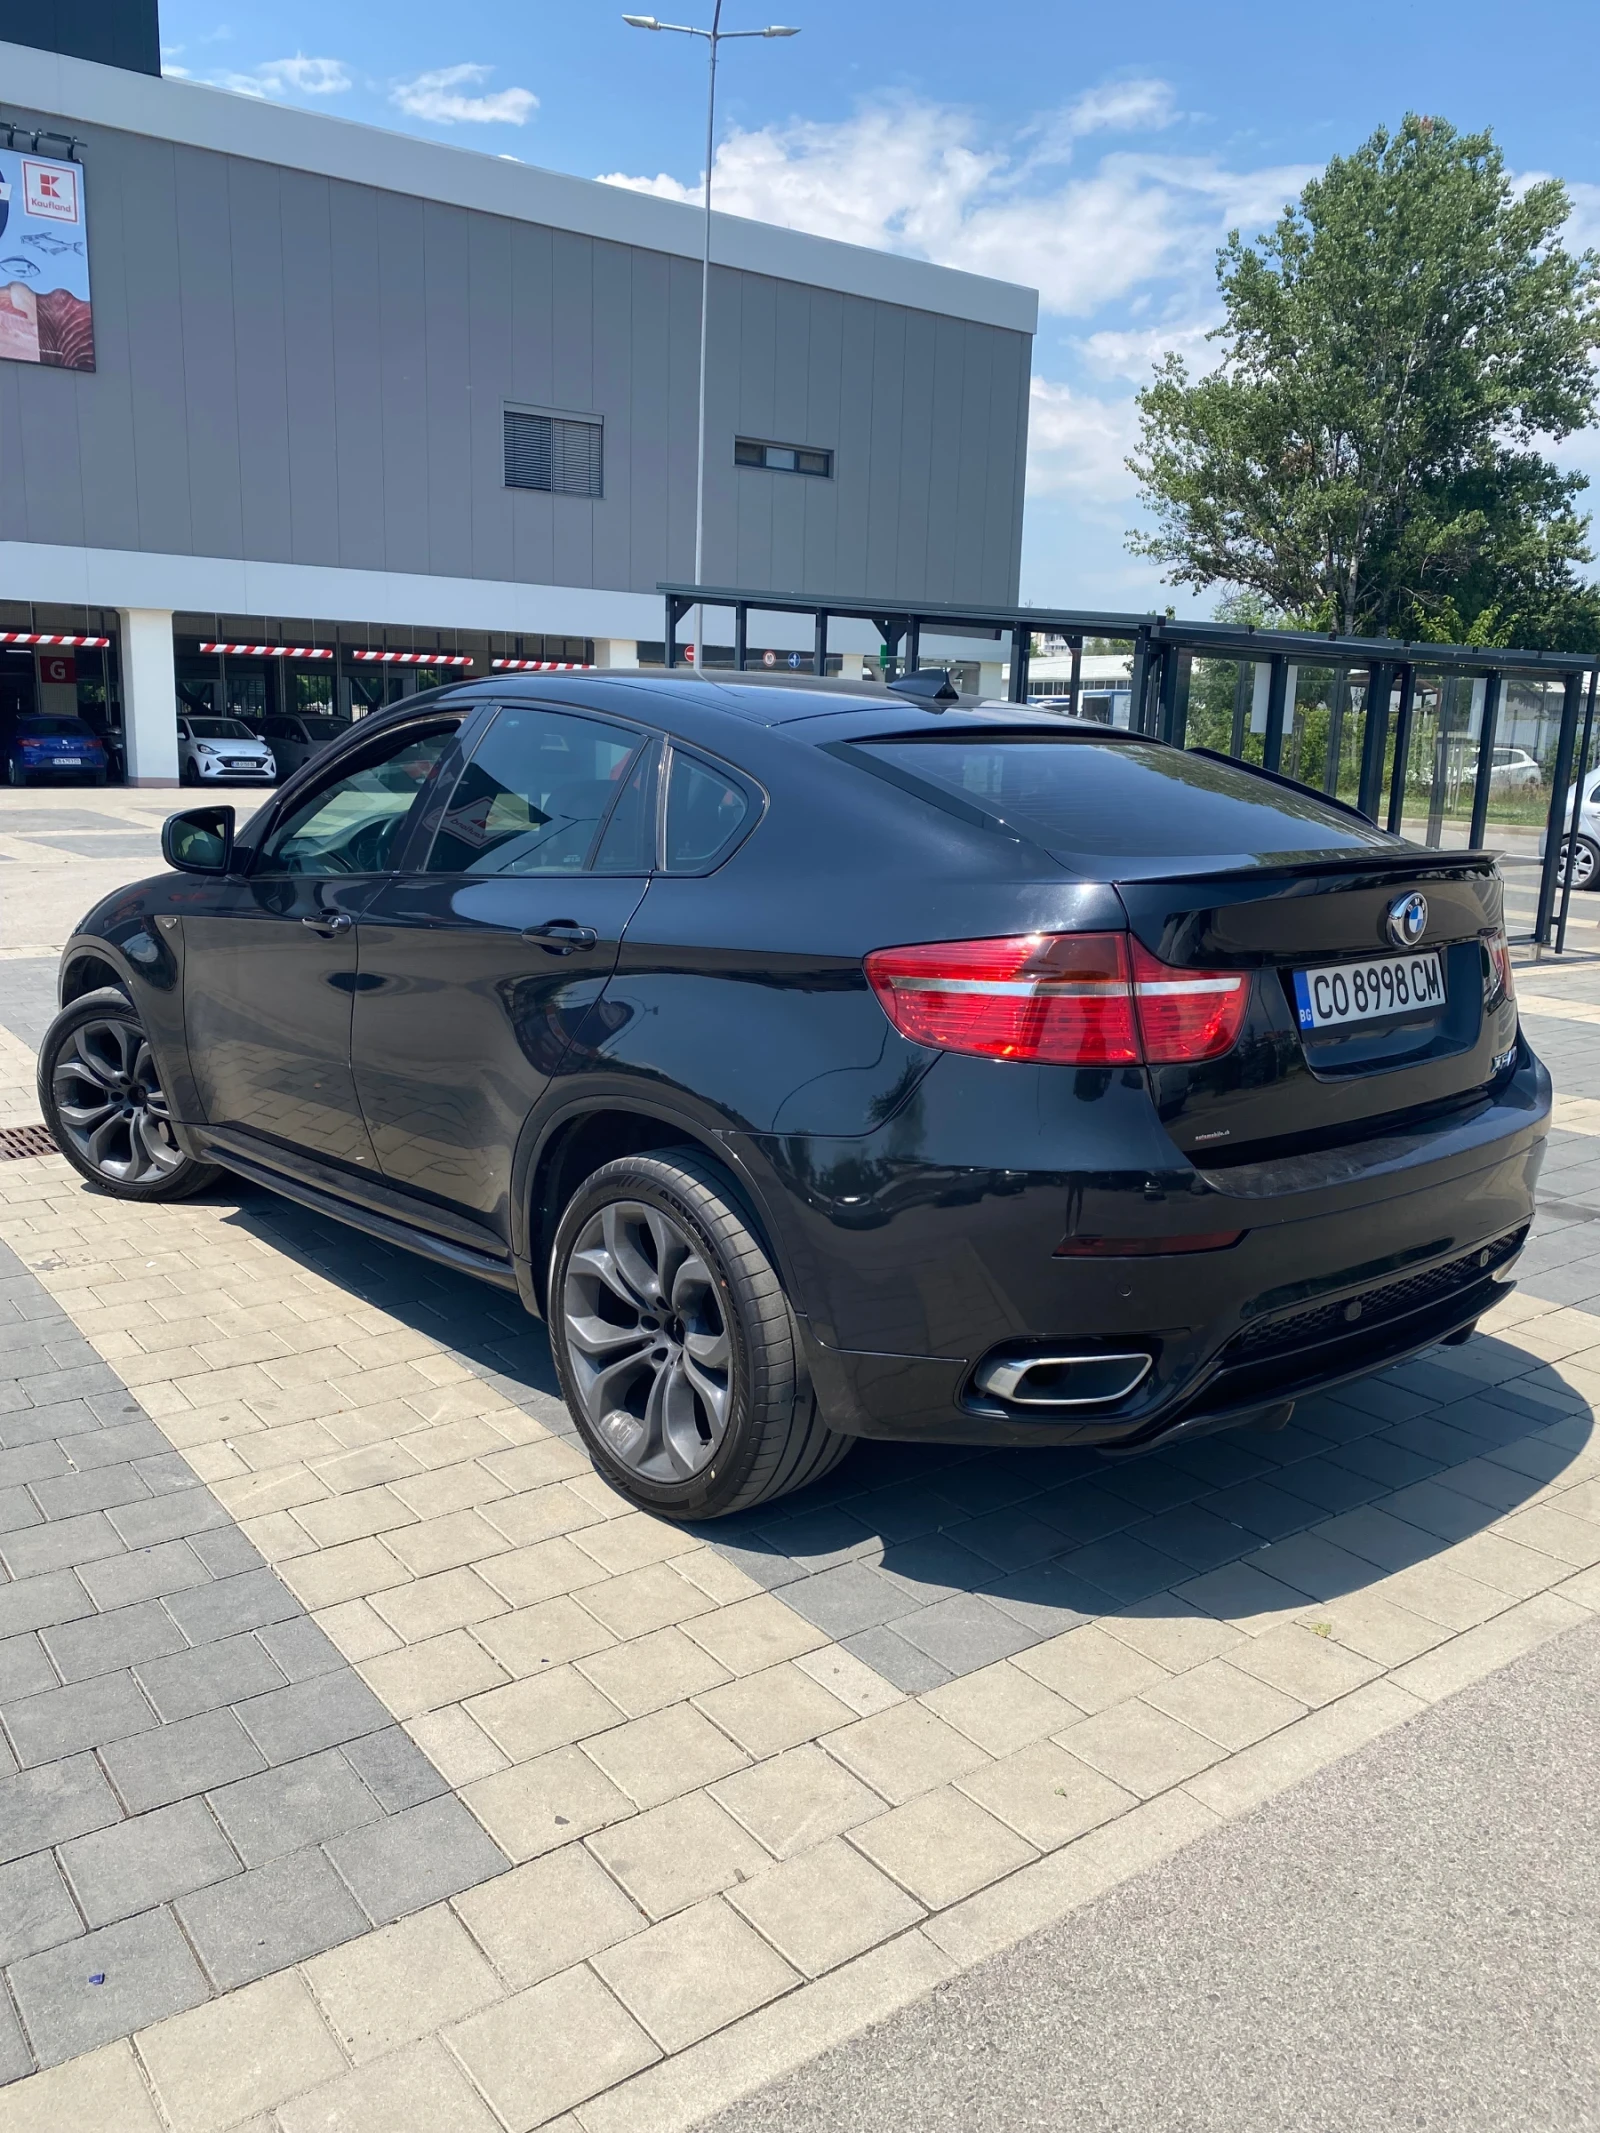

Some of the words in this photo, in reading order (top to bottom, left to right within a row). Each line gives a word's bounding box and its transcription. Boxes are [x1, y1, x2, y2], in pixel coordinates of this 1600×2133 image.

[31, 198, 72, 213] Kaufland
[50, 660, 66, 680] G
[1314, 972, 1350, 1020] CO
[1352, 963, 1410, 1013] 8998
[1411, 957, 1441, 1003] CM
[1300, 1009, 1312, 1023] BG
